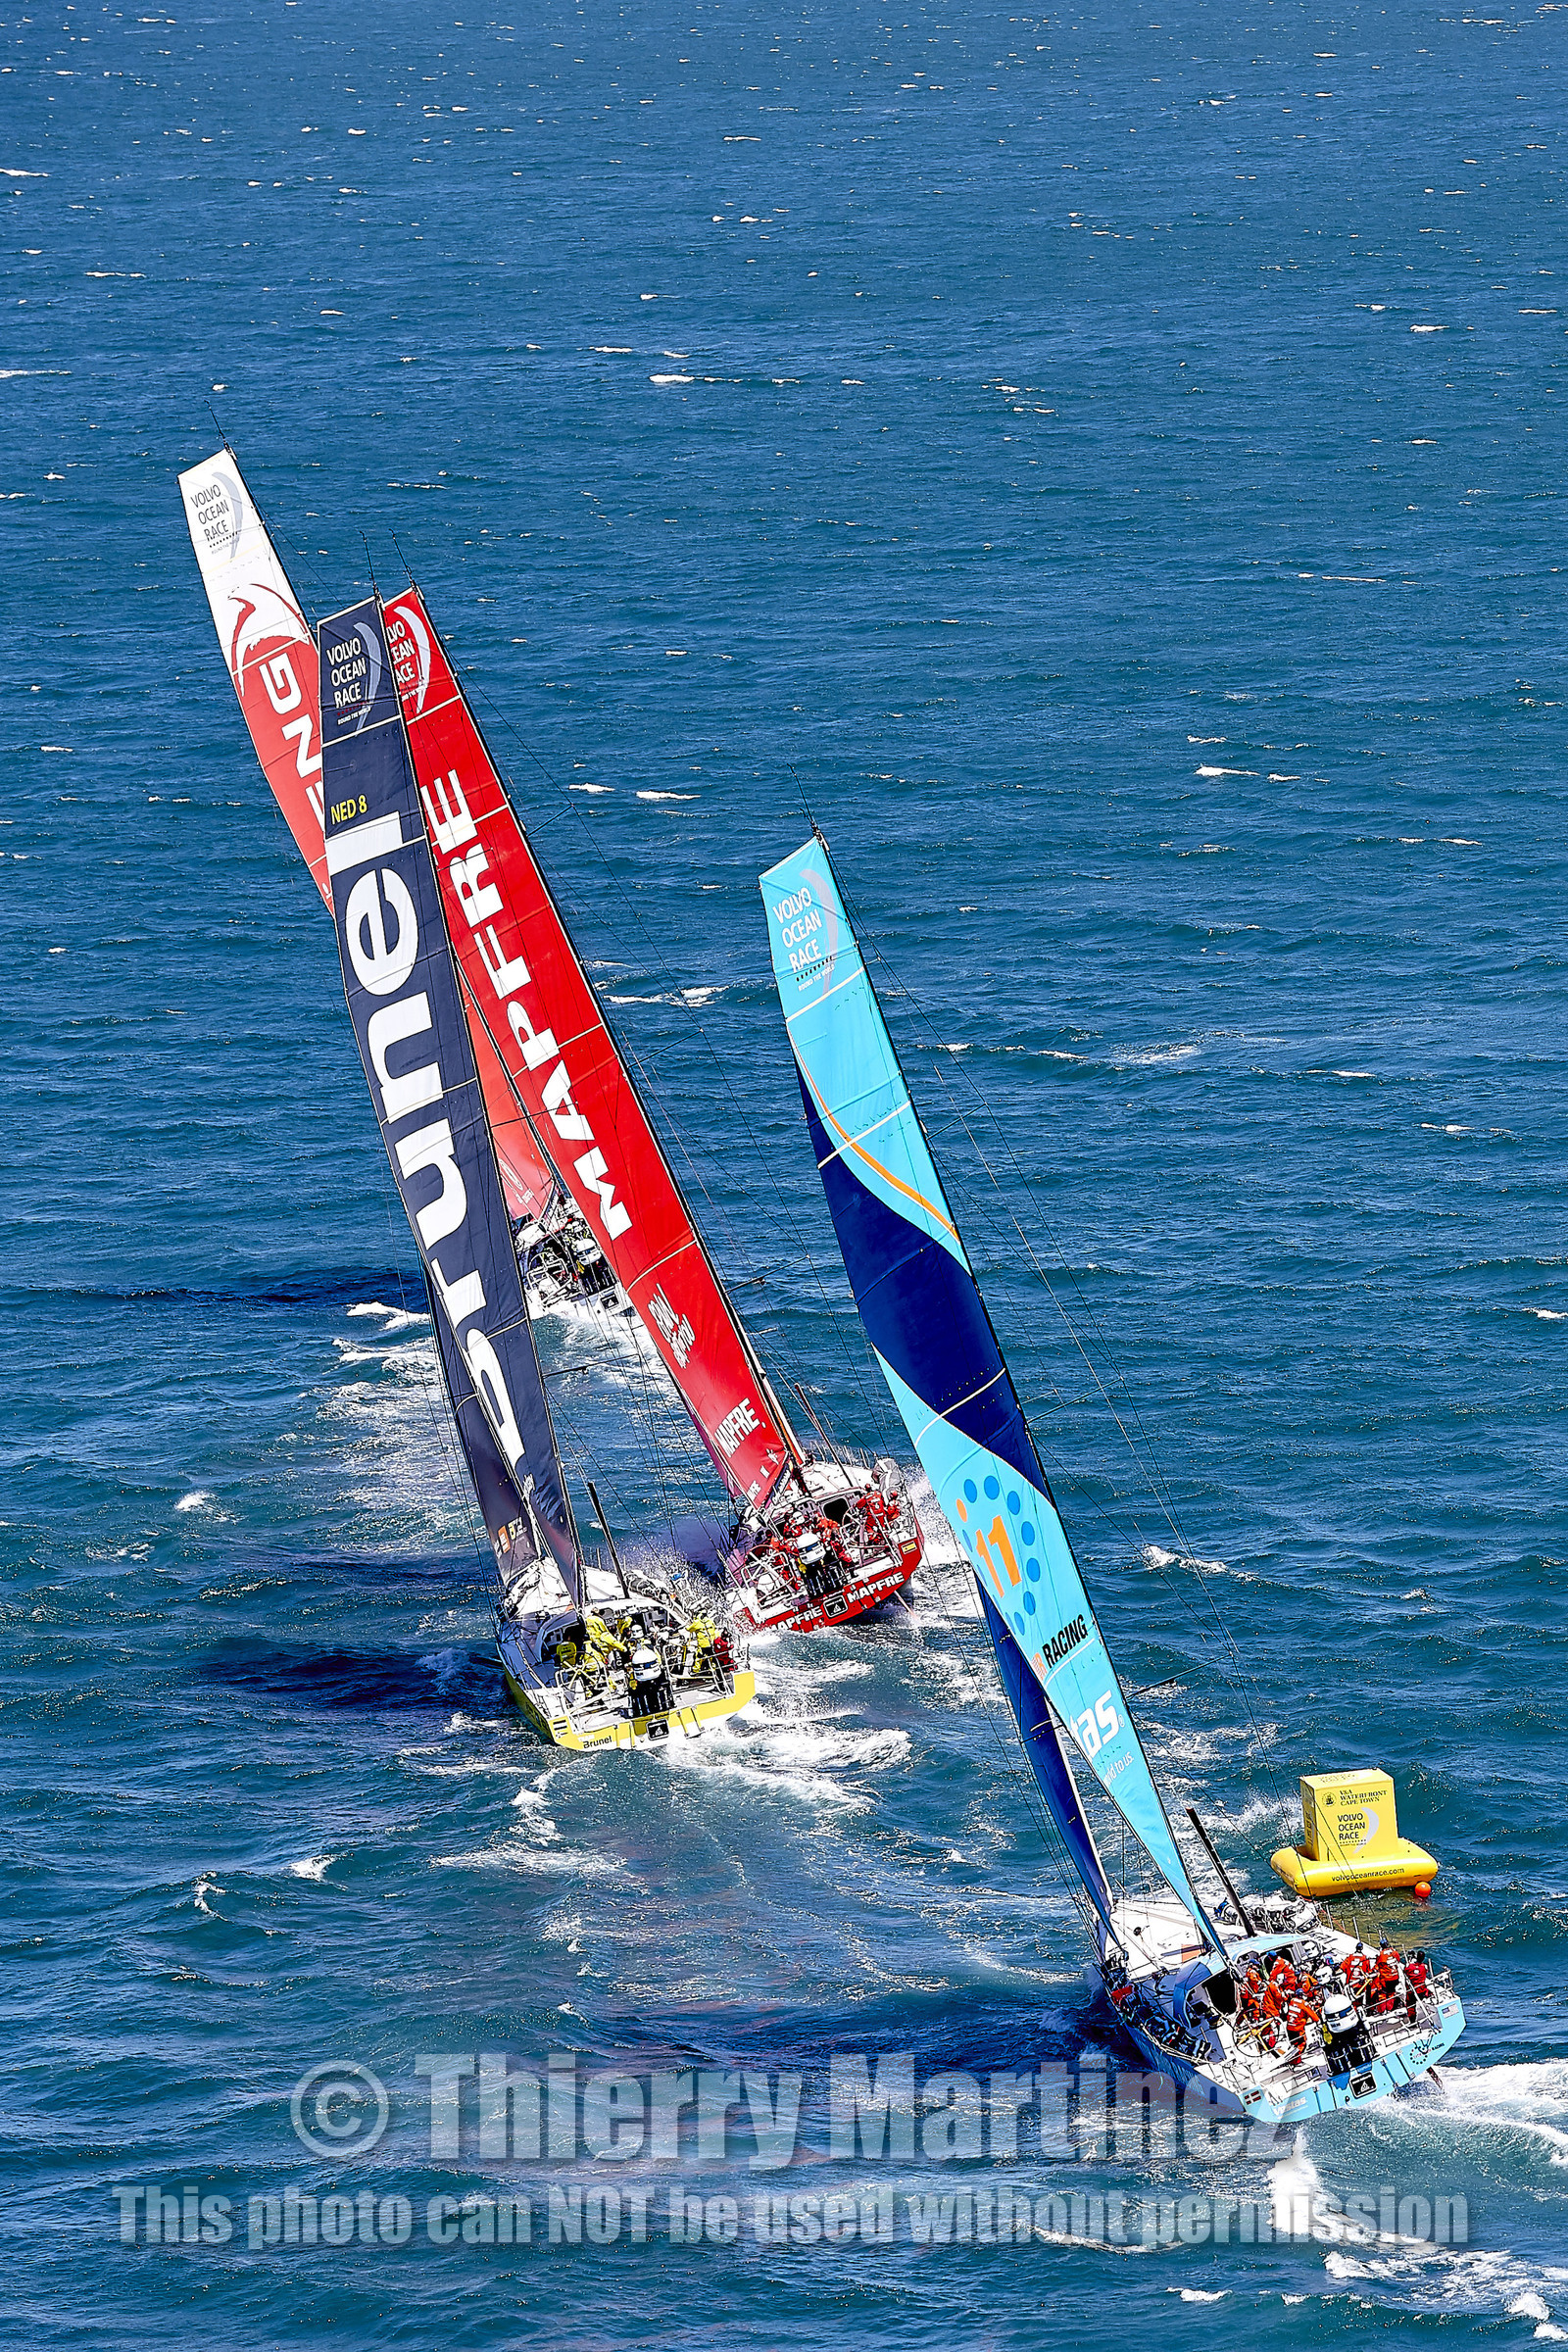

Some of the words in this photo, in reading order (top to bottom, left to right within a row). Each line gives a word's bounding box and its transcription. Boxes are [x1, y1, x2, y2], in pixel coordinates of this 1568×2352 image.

[190, 484, 221, 508] VOLVO
[198, 499, 229, 524] OCEAN
[204, 519, 228, 542] RACE
[326, 637, 361, 665] VOLVO
[331, 657, 367, 687] OCEAN
[334, 682, 362, 709] RACE
[330, 799, 356, 825] NED
[358, 794, 368, 813] 8
[772, 887, 812, 924] VOLVO
[781, 908, 823, 948] OCEAN
[788, 939, 822, 973] RACE
[420, 768, 634, 1242] MAPFRE
[713, 1397, 760, 1458] MAPFRE
[975, 1515, 1022, 1598] 11
[847, 1572, 905, 1603] MAPFRE
[1042, 1614, 1089, 1669] RACING
[583, 1736, 612, 1748] Brunel
[1114, 1759, 1125, 1774] to
[1337, 1812, 1363, 1823] VOLVO
[1338, 1822, 1365, 1832] OCEAN
[1339, 1832, 1359, 1840] RACE
[1331, 1867, 1405, 1883] volvooceanrace.com
